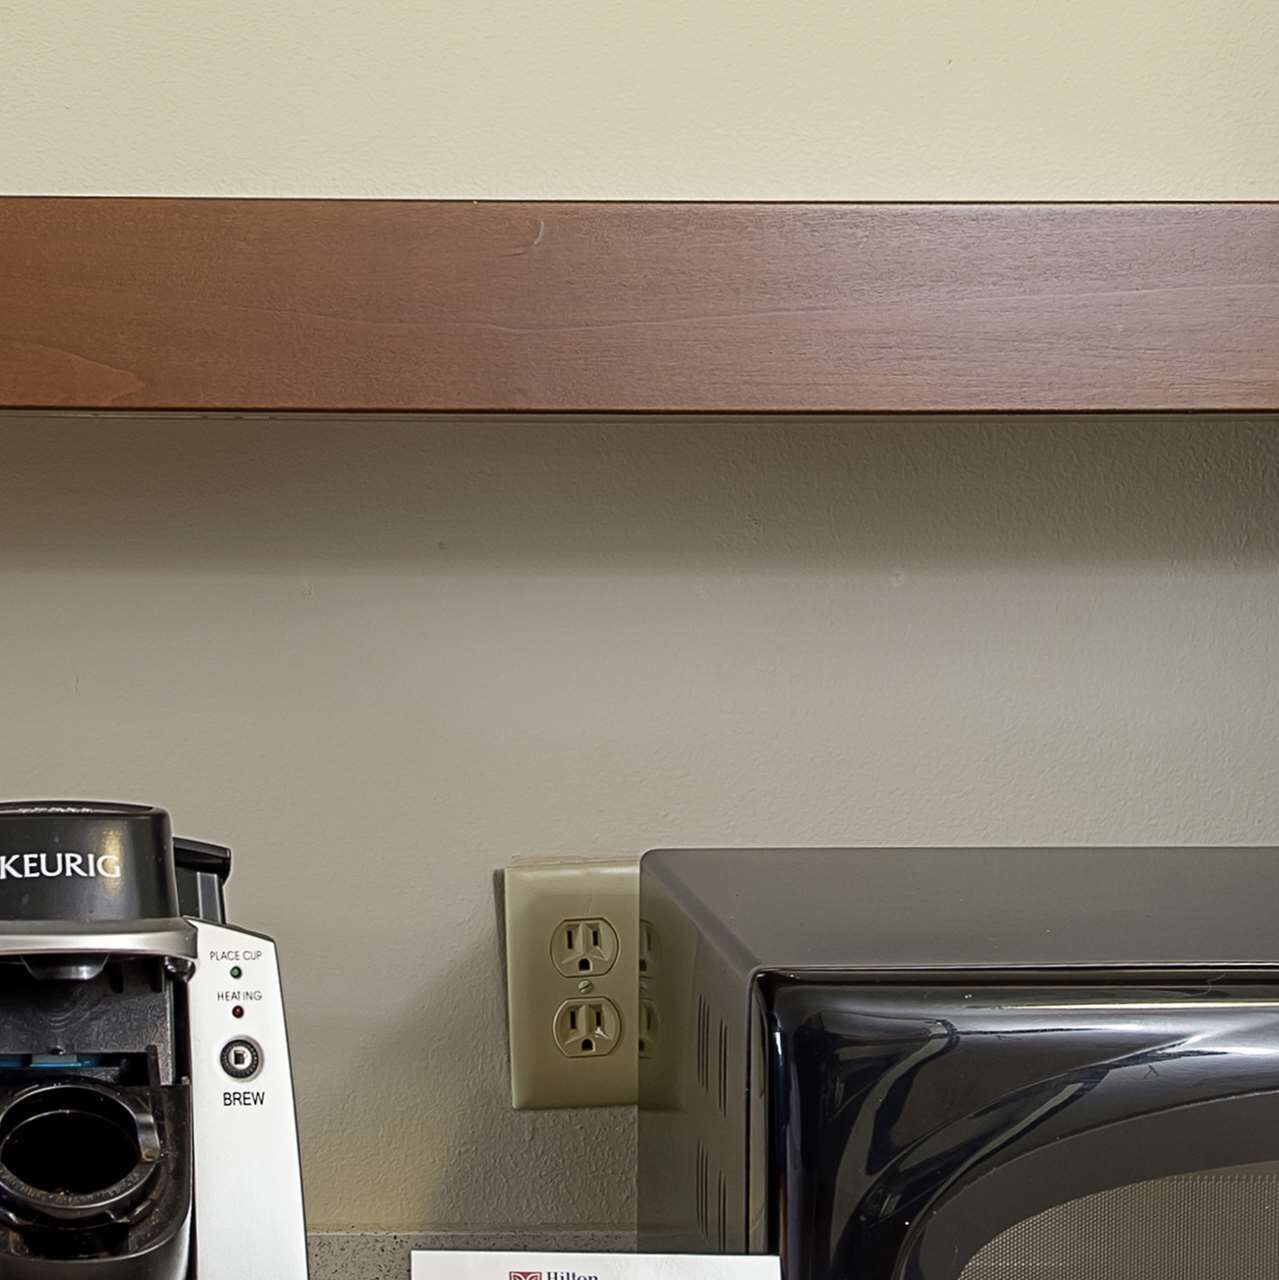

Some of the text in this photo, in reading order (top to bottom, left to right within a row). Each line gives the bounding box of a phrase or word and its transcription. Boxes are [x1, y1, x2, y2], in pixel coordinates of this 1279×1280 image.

[0, 853, 120, 879] KEURIG
[209, 951, 262, 960] PLACE CUP
[217, 991, 262, 1001] HEATING
[223, 1091, 265, 1107] BREW
